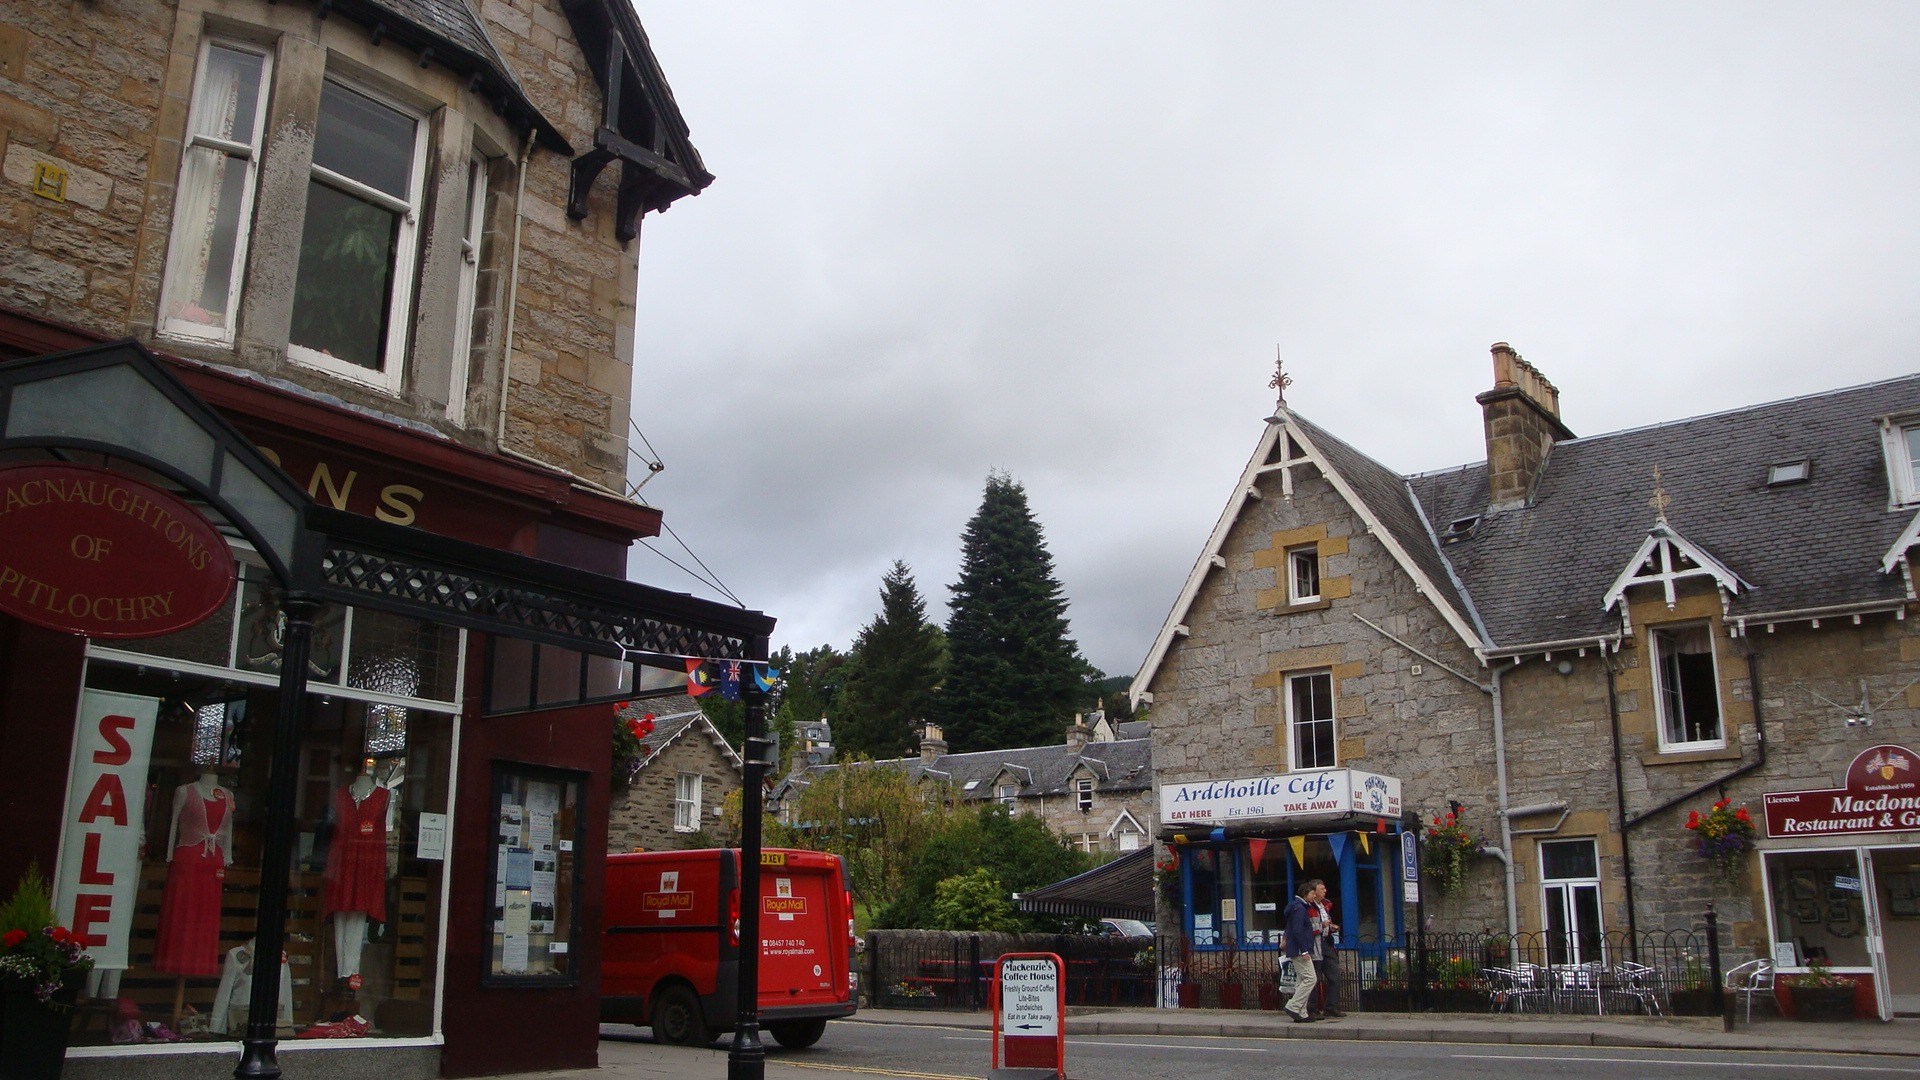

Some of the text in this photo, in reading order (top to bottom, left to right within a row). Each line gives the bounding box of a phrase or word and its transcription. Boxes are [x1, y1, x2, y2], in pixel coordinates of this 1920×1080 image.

[257, 446, 424, 526] NS
[0, 479, 213, 570] ACNAUGHTONS
[71, 534, 112, 562] OF
[0, 566, 174, 621] PITLOCHRY
[1174, 772, 1335, 802] Ardchoille Cafe
[1354, 790, 1362, 799] EAT
[1767, 795, 1800, 804] Licensed
[1353, 801, 1364, 809] HERE
[1388, 796, 1399, 805] TAKE
[1228, 806, 1265, 816] Est. 1961
[1284, 800, 1338, 812] TAKE AWAY
[1388, 806, 1399, 815] AWAY
[1171, 810, 1212, 820] EAT HERE
[1783, 811, 1920, 832] Restaurant & G
[72, 714, 136, 947] SALE
[768, 853, 782, 863] XEV
[646, 894, 690, 908] Royal Mail
[766, 899, 804, 911] Royal Mail
[769, 948, 815, 956] www.royalmail.com
[1004, 972, 1055, 981] Coffee House
[1004, 985, 1021, 994] Freshly
[1016, 1003, 1043, 1011] Sandwiches
